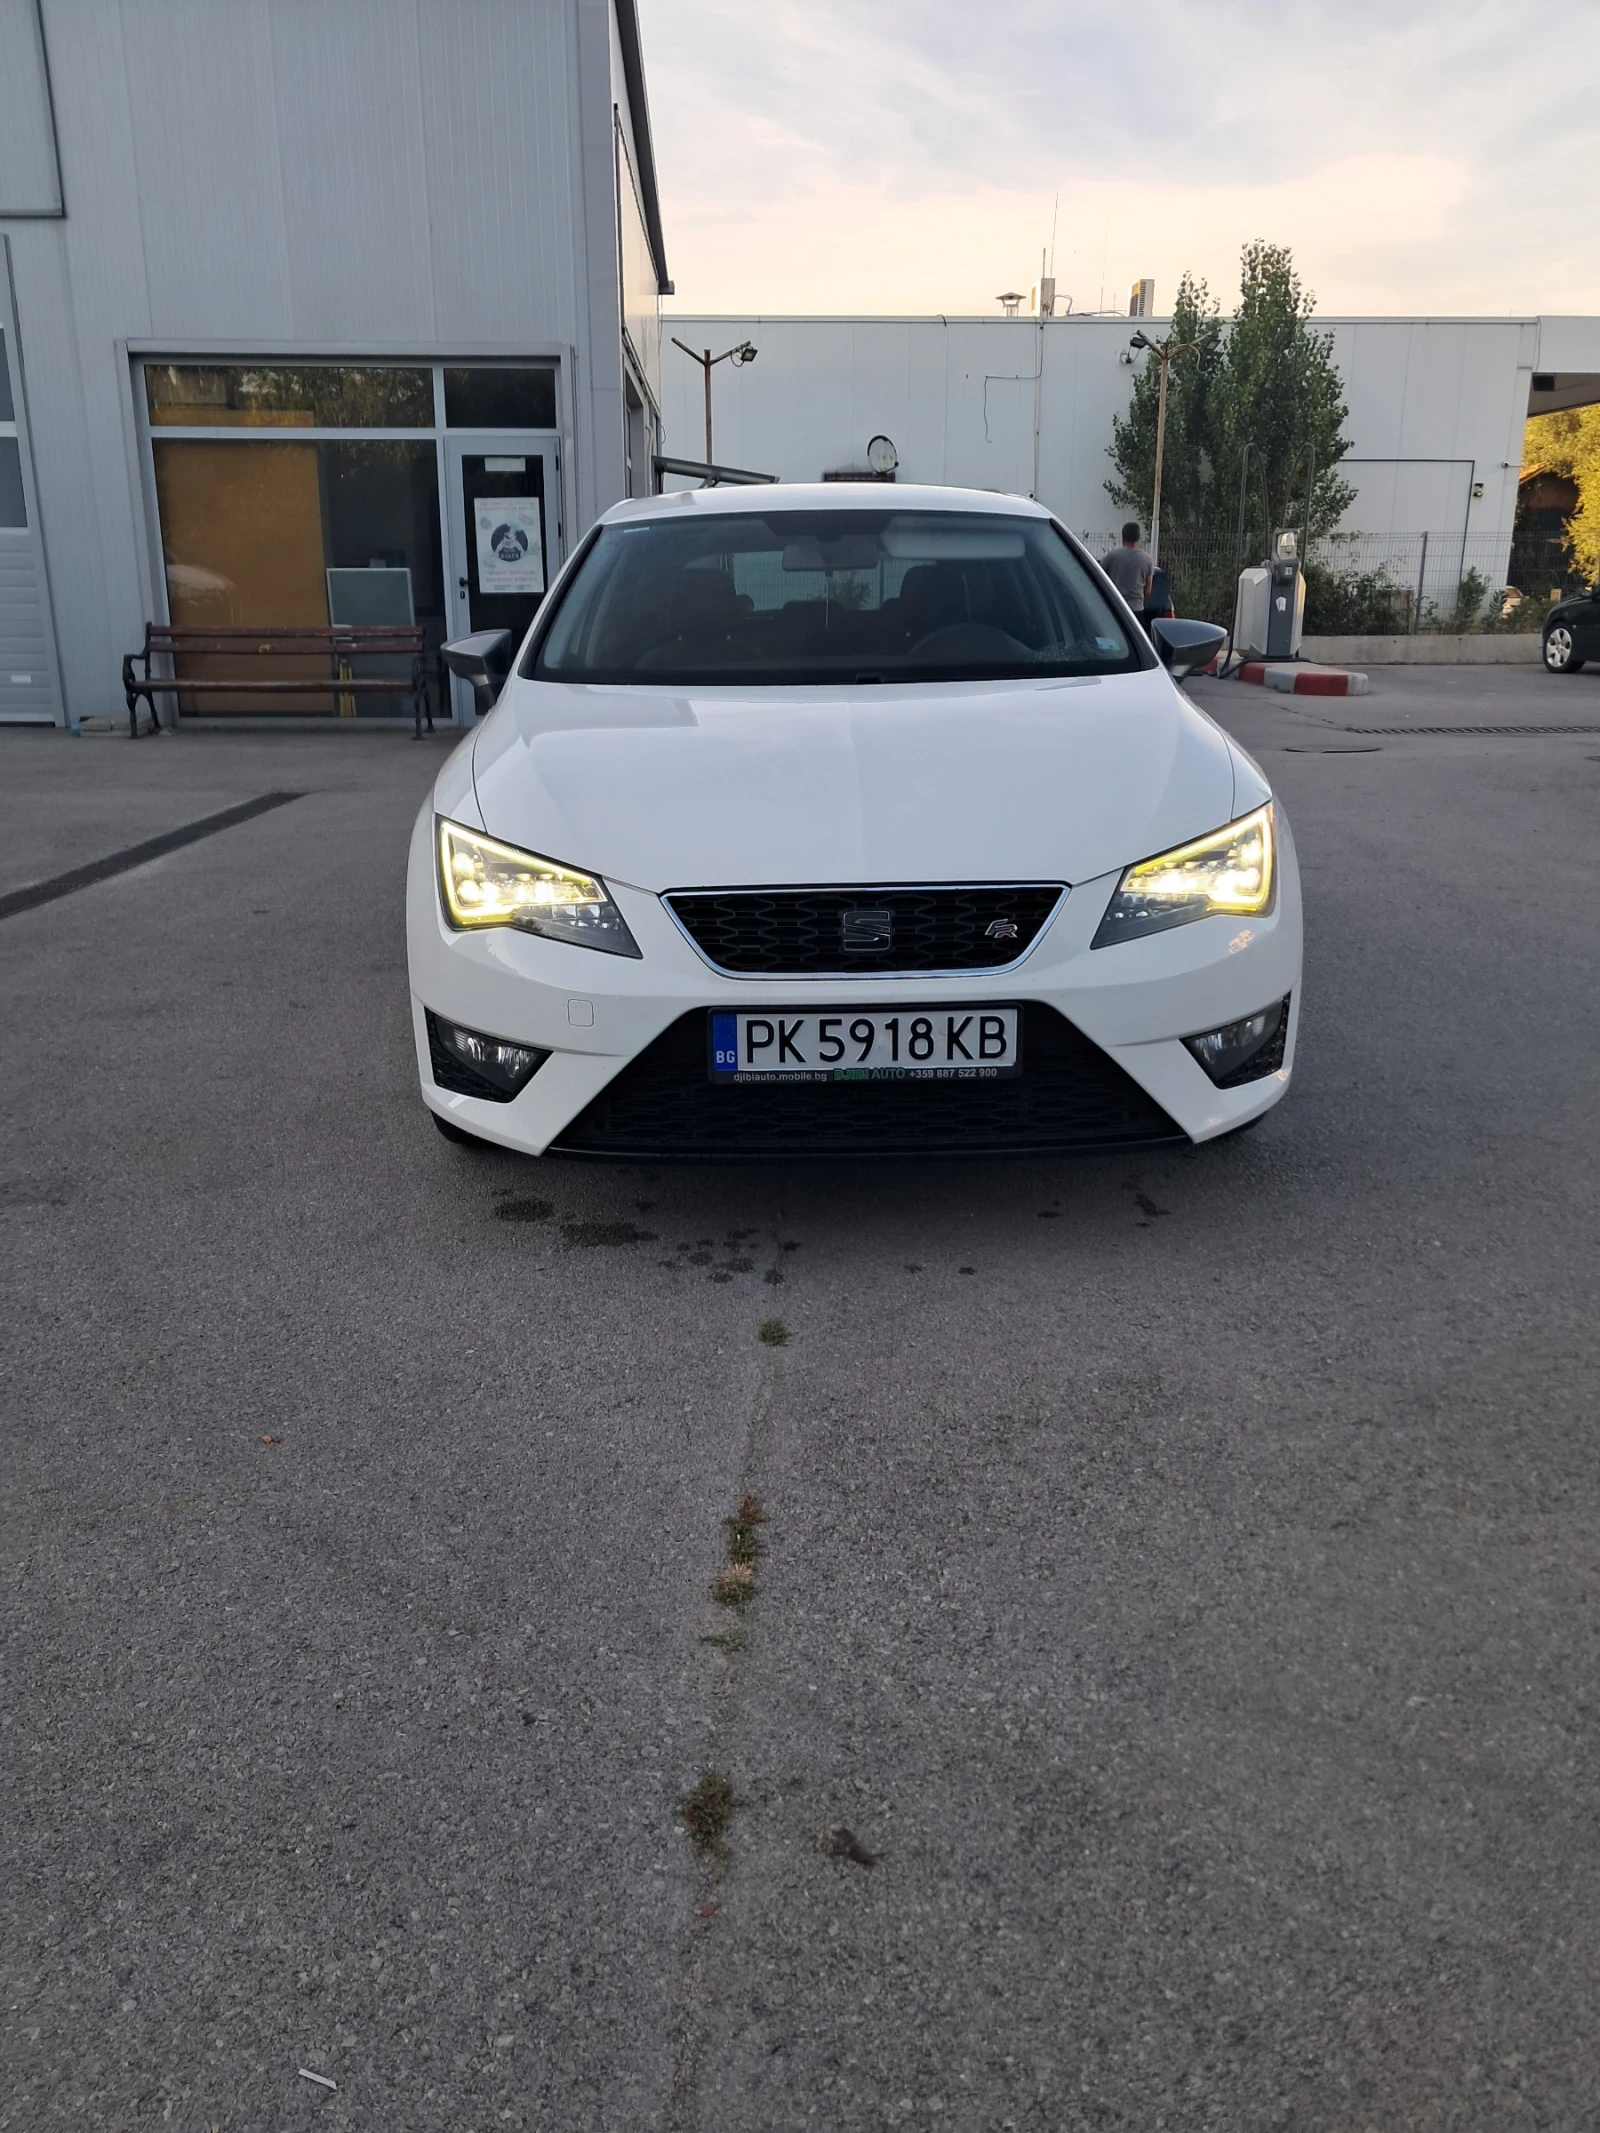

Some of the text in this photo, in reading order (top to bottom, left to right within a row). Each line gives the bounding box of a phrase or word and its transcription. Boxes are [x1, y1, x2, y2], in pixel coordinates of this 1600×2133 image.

[746, 1016, 1007, 1063] PK 5918 KB
[716, 1050, 735, 1063] BG
[733, 1072, 828, 1082] djibiauto.mobile.bg
[871, 1068, 906, 1079] AUTO
[909, 1069, 934, 1078] +359
[936, 1069, 955, 1078] 887
[958, 1068, 977, 1077] 522
[978, 1068, 997, 1077] 900
